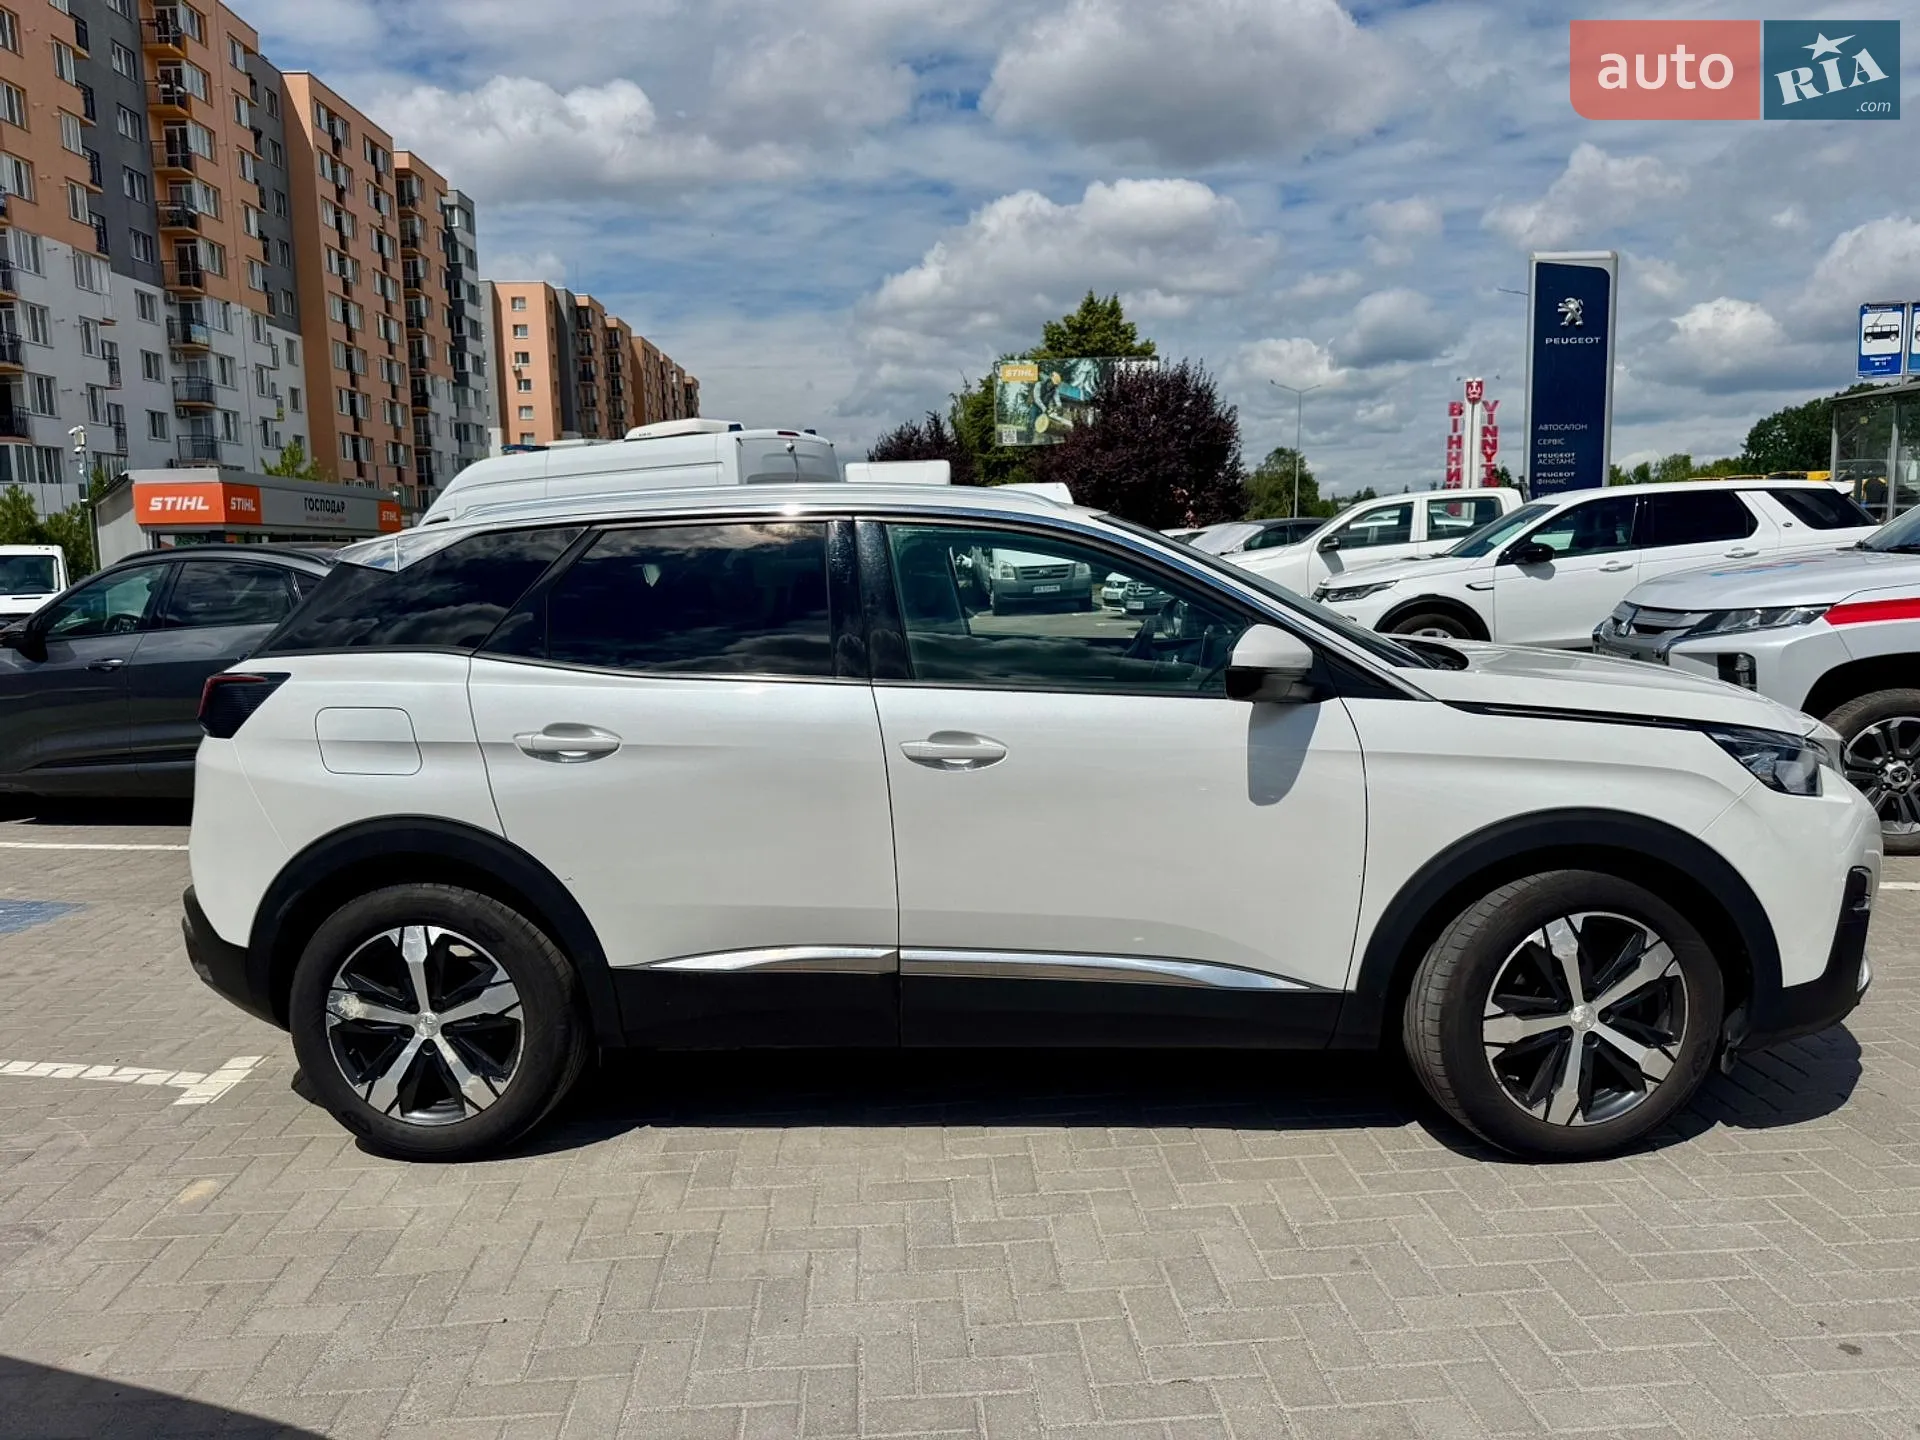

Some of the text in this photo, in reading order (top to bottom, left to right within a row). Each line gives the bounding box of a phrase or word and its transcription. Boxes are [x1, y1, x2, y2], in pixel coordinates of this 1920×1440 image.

[1545, 336, 1601, 345] PEUGEOT
[1538, 423, 1588, 432] АВТОСАЛОН
[1537, 437, 1566, 446] СЕРВІС
[149, 496, 210, 511] STIHL
[230, 496, 256, 512] STIHL
[303, 497, 346, 515] ГОСПОДАР
[382, 510, 399, 522] STIHL
